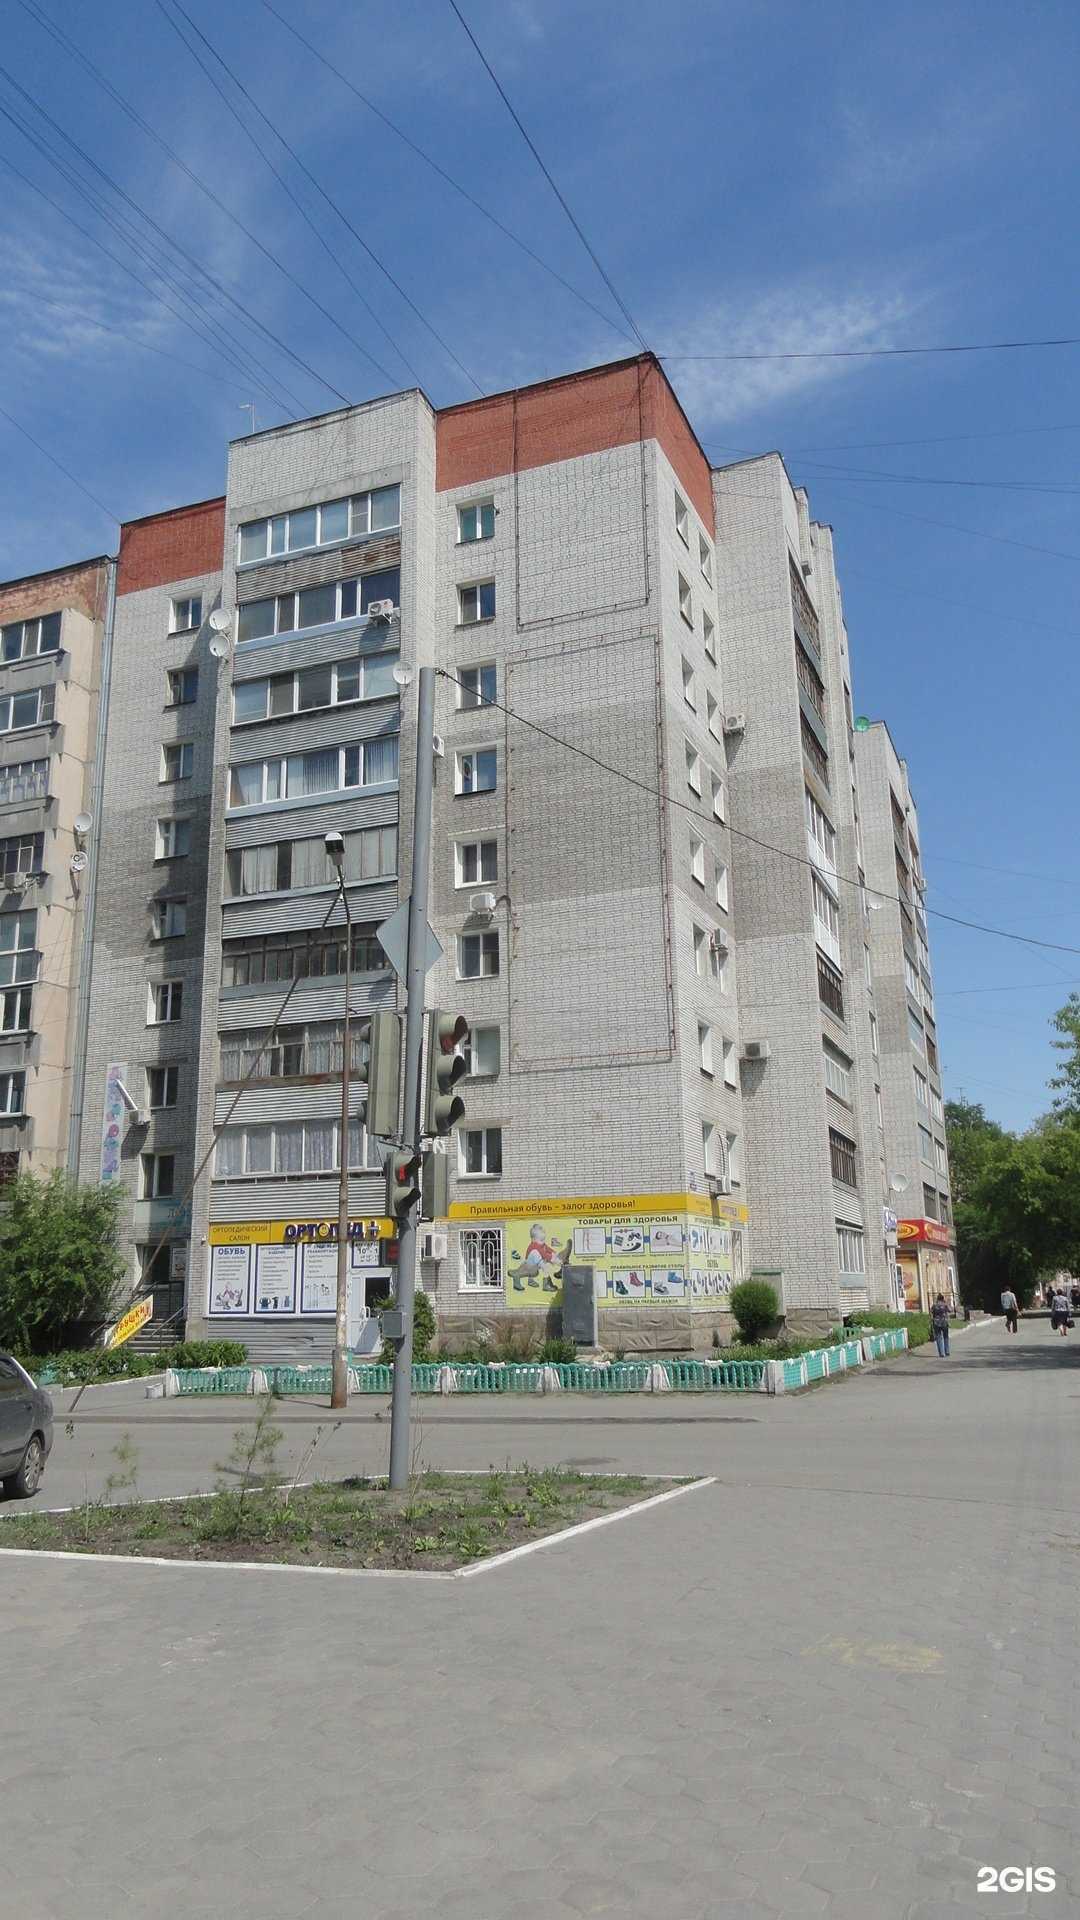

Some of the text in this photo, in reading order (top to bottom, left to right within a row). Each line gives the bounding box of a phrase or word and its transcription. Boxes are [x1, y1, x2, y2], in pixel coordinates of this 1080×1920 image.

[470, 1205, 524, 1215] Правильная
[526, 1203, 552, 1214] обувь
[562, 1203, 586, 1211] залог
[589, 1200, 636, 1211] здоровья!
[633, 1216, 678, 1224] ЗДОРОВЬЯ
[213, 1225, 268, 1233] ОРТОПЕДИЧЕСКИЙ
[218, 1247, 246, 1256] ОБУВЬ
